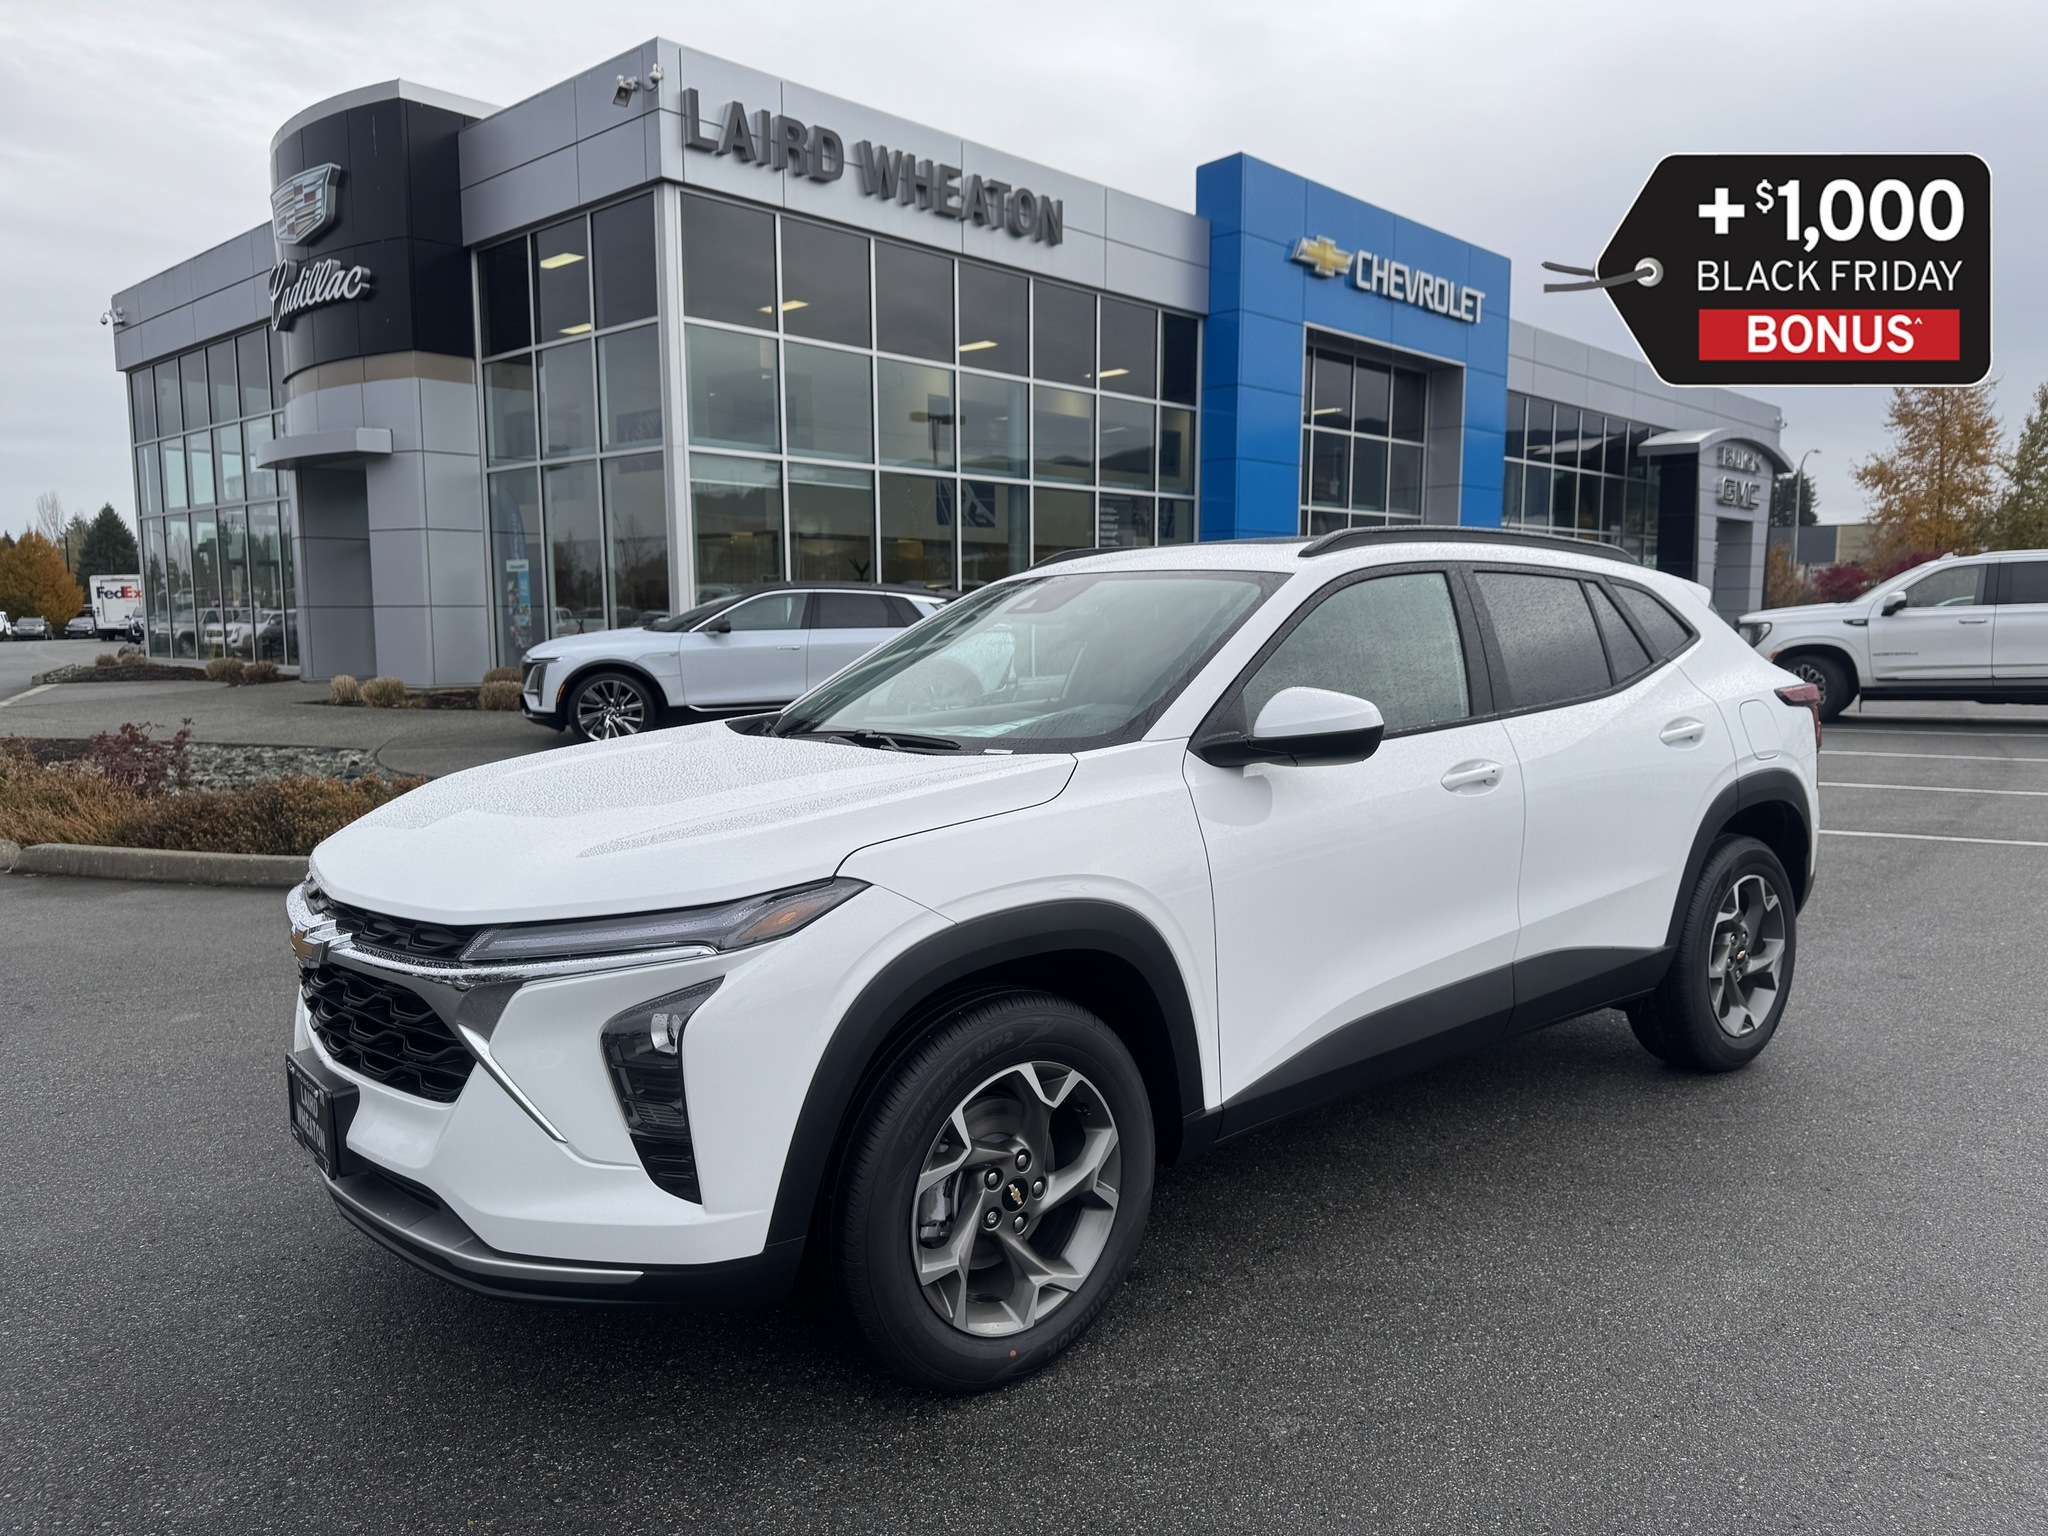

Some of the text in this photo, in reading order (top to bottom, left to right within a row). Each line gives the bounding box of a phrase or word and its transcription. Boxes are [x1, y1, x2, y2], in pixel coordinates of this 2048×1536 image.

[682, 88, 1063, 246] LAIRD WHEATON
[269, 258, 369, 332] Cadillac
[1355, 249, 1486, 325] CHEVROLET
[1719, 446, 1763, 472] BUICK
[1717, 476, 1761, 510] GMC
[96, 586, 142, 598] FedEx
[300, 1084, 319, 1119] LAIRD
[296, 1102, 327, 1154] WHEATON
